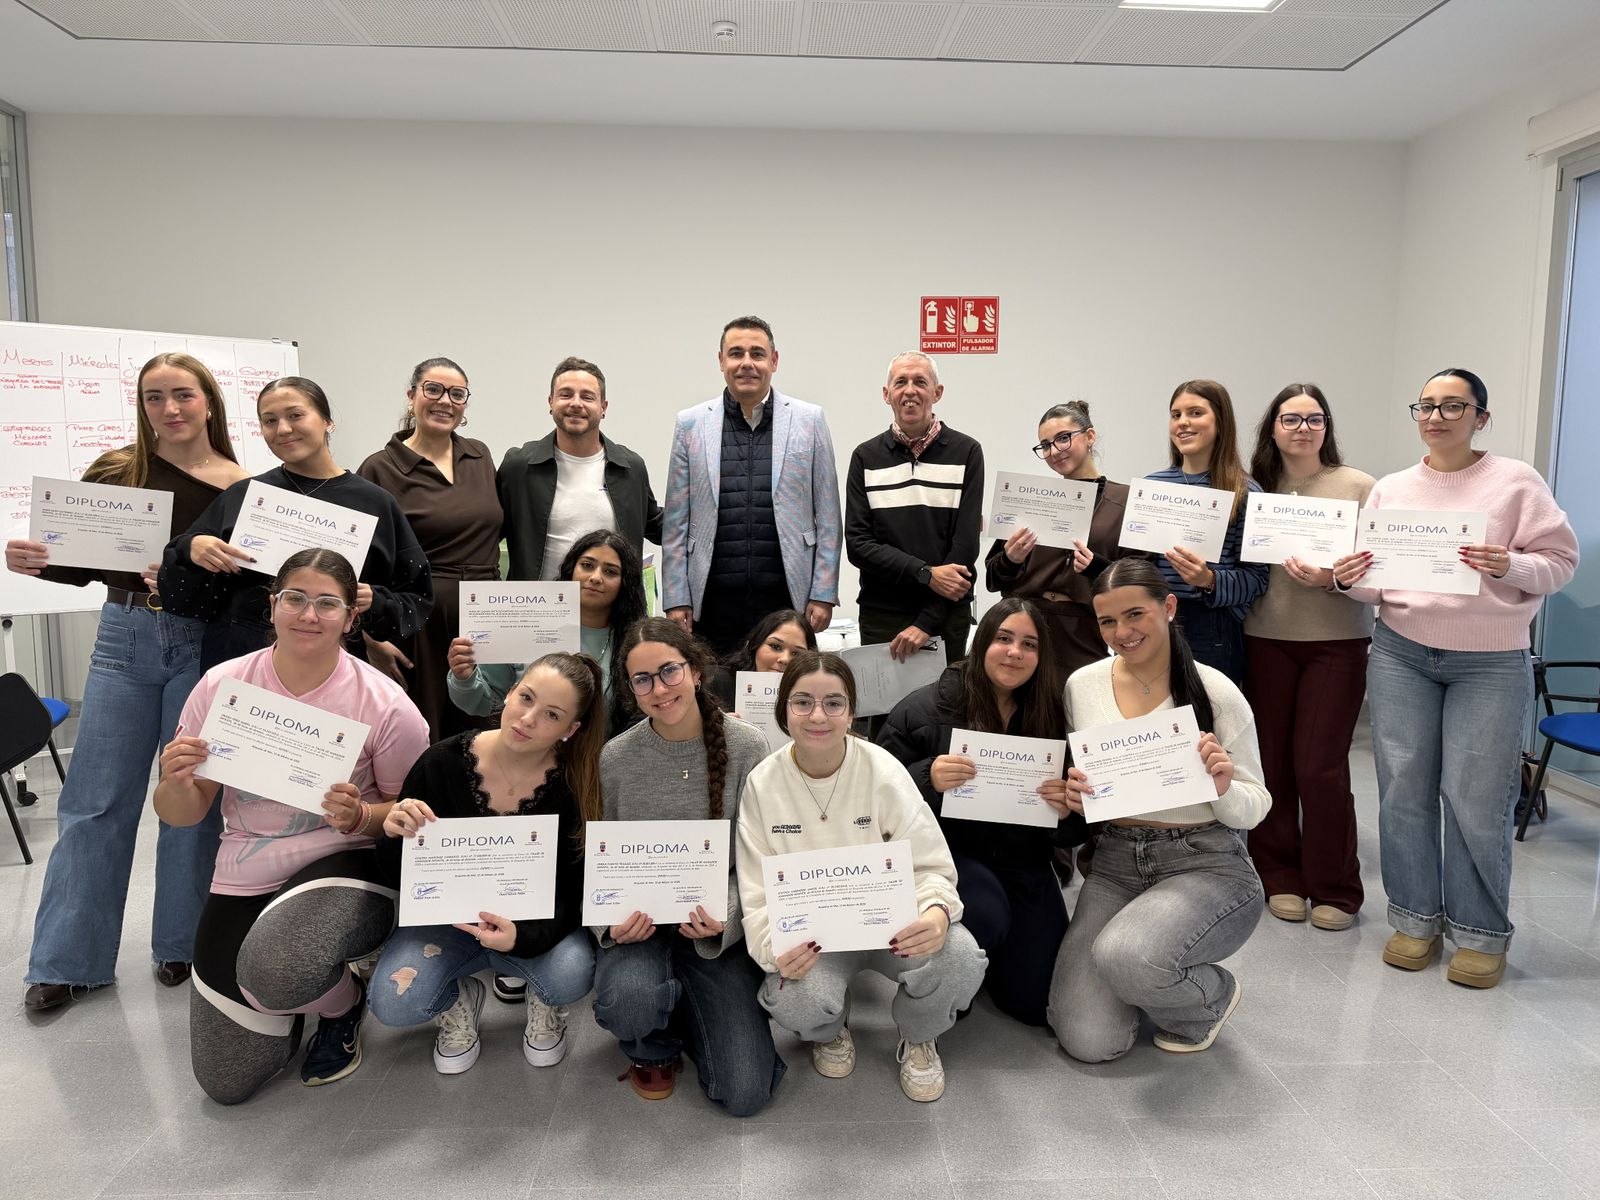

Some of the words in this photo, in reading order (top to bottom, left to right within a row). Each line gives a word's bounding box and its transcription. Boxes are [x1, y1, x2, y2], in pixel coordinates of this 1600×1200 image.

[922, 341, 956, 349] EXTINTOR
[1018, 486, 1067, 499] DIPLOMA
[65, 496, 133, 512] DIPLOMA
[1151, 493, 1201, 507] DIPLOMA
[275, 505, 337, 530] DIPLOMA
[1273, 506, 1326, 518] DIPLOMA
[1387, 523, 1448, 535] DIPLOMA
[488, 595, 547, 604] DIPLOMA
[249, 705, 321, 738] DIPLOMA
[1100, 730, 1162, 752] DIPLOMA
[979, 748, 1036, 763] DIPLOMA
[441, 835, 515, 848] DIPLOMA
[621, 843, 690, 854] DIPLOMA
[799, 864, 872, 881] DIPLOMA
